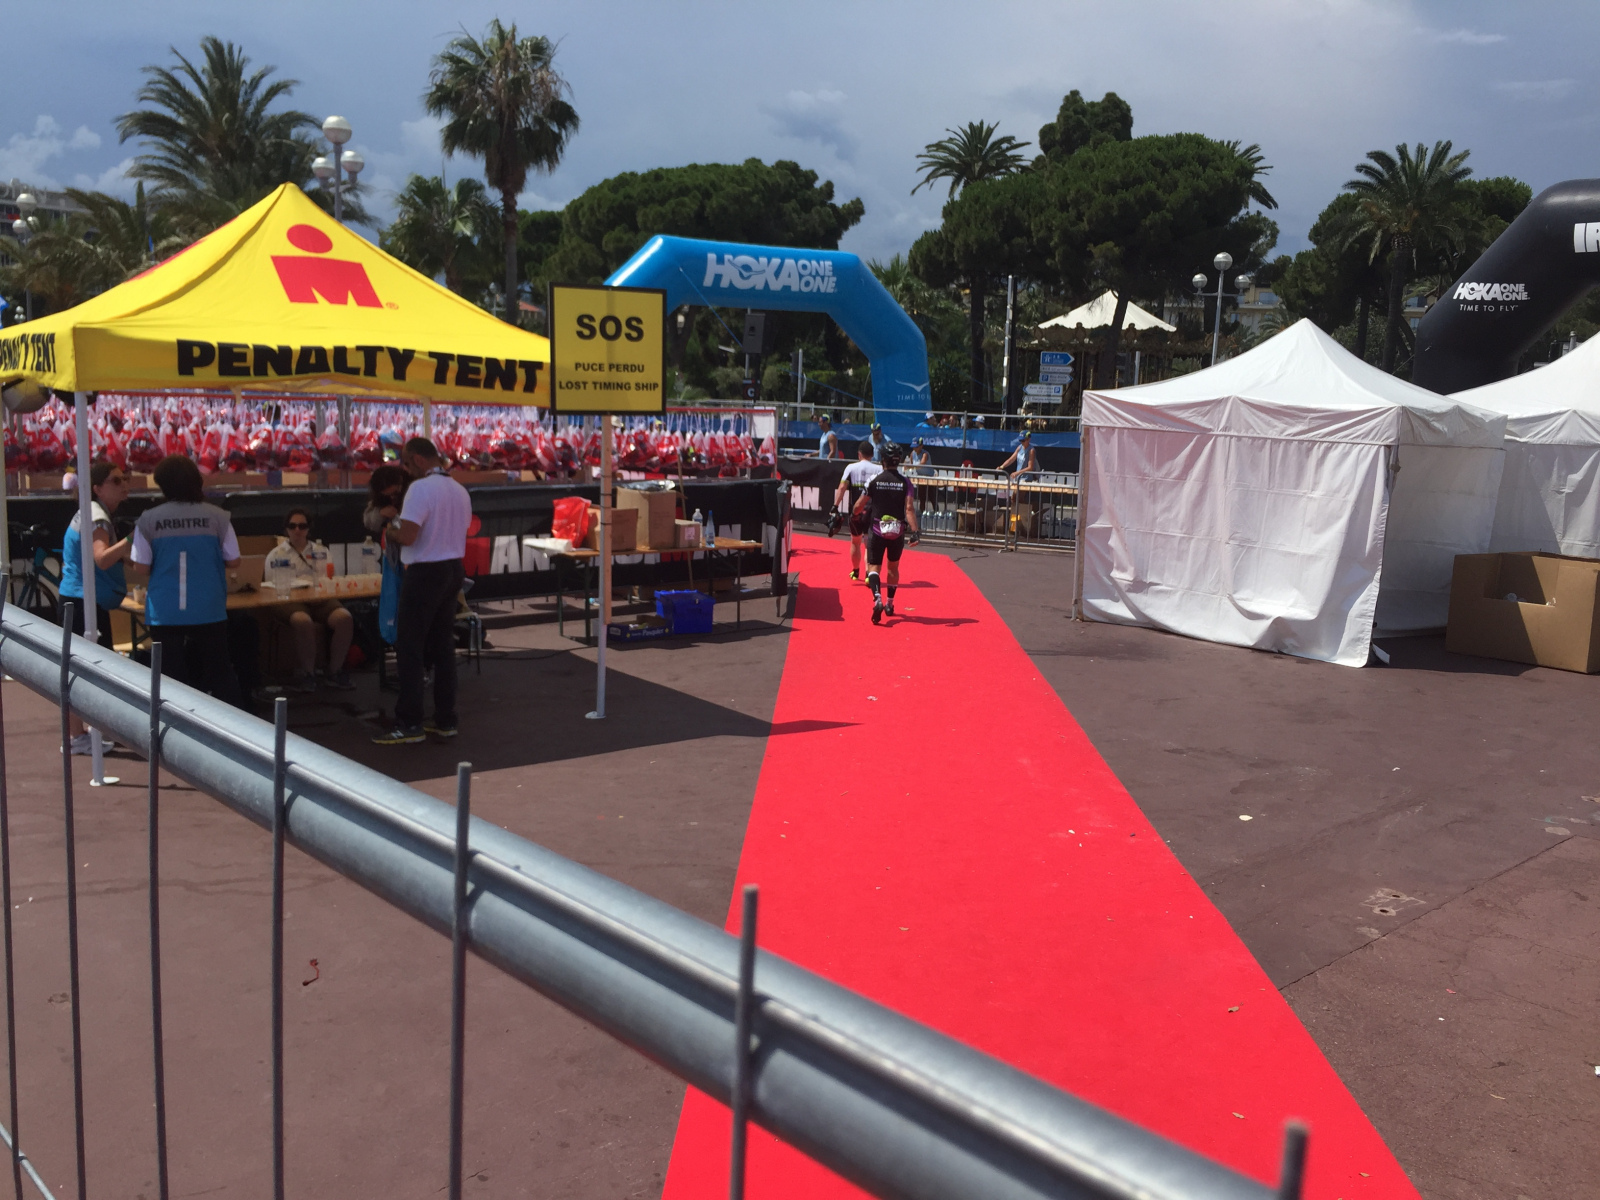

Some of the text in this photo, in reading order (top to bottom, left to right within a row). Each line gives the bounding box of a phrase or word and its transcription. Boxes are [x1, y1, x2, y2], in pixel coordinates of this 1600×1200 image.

[703, 253, 833, 292] HOKA ONE
[800, 276, 837, 293] ONE
[1453, 282, 1525, 301] HOKA ONE
[1502, 292, 1528, 301] ONE
[1460, 304, 1479, 312] TIME
[576, 314, 644, 342] SOS
[31, 332, 56, 373] TENT
[176, 339, 544, 393] PENALTY TENT
[575, 363, 645, 373] PUCE PERDU
[559, 381, 659, 391] LOST TIMING SHIP
[155, 517, 210, 531] ARBITRE
